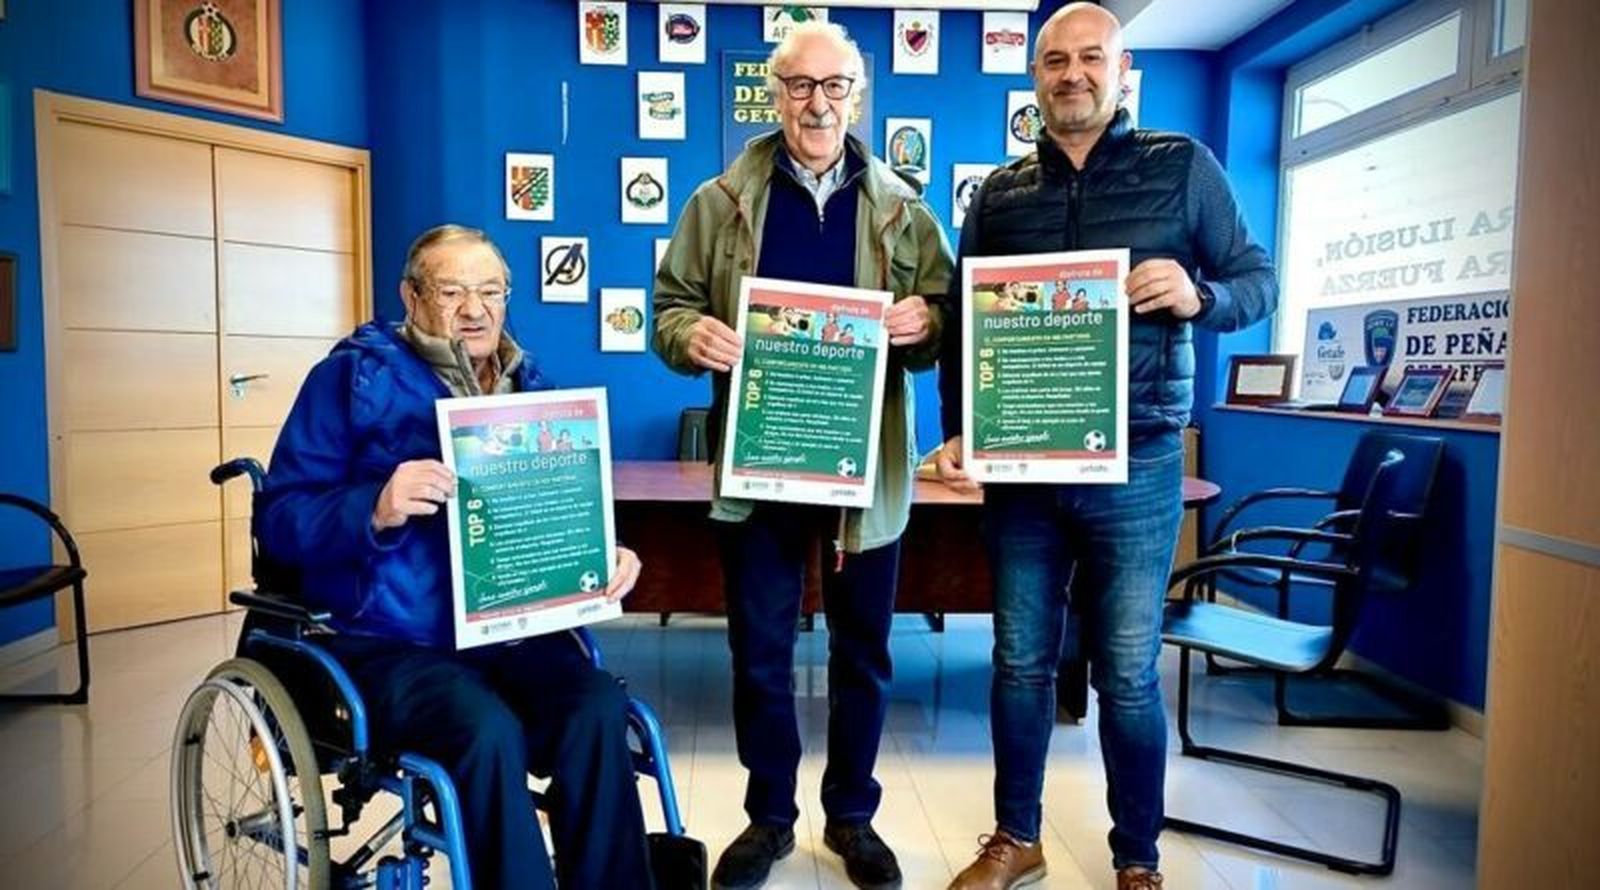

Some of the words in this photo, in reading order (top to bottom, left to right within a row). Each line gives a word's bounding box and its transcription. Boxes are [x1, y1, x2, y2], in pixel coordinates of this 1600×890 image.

[734, 86, 769, 102] DE
[983, 314, 1041, 329] nuestro
[1043, 311, 1103, 329] deporte
[755, 339, 809, 355] nuestro
[812, 341, 865, 360] deporte
[1405, 335, 1437, 356] DE
[979, 361, 994, 392] TOP
[745, 381, 761, 410] TOP
[471, 460, 528, 476] nuestro
[531, 453, 587, 470] deporte
[468, 513, 486, 547] TOP
